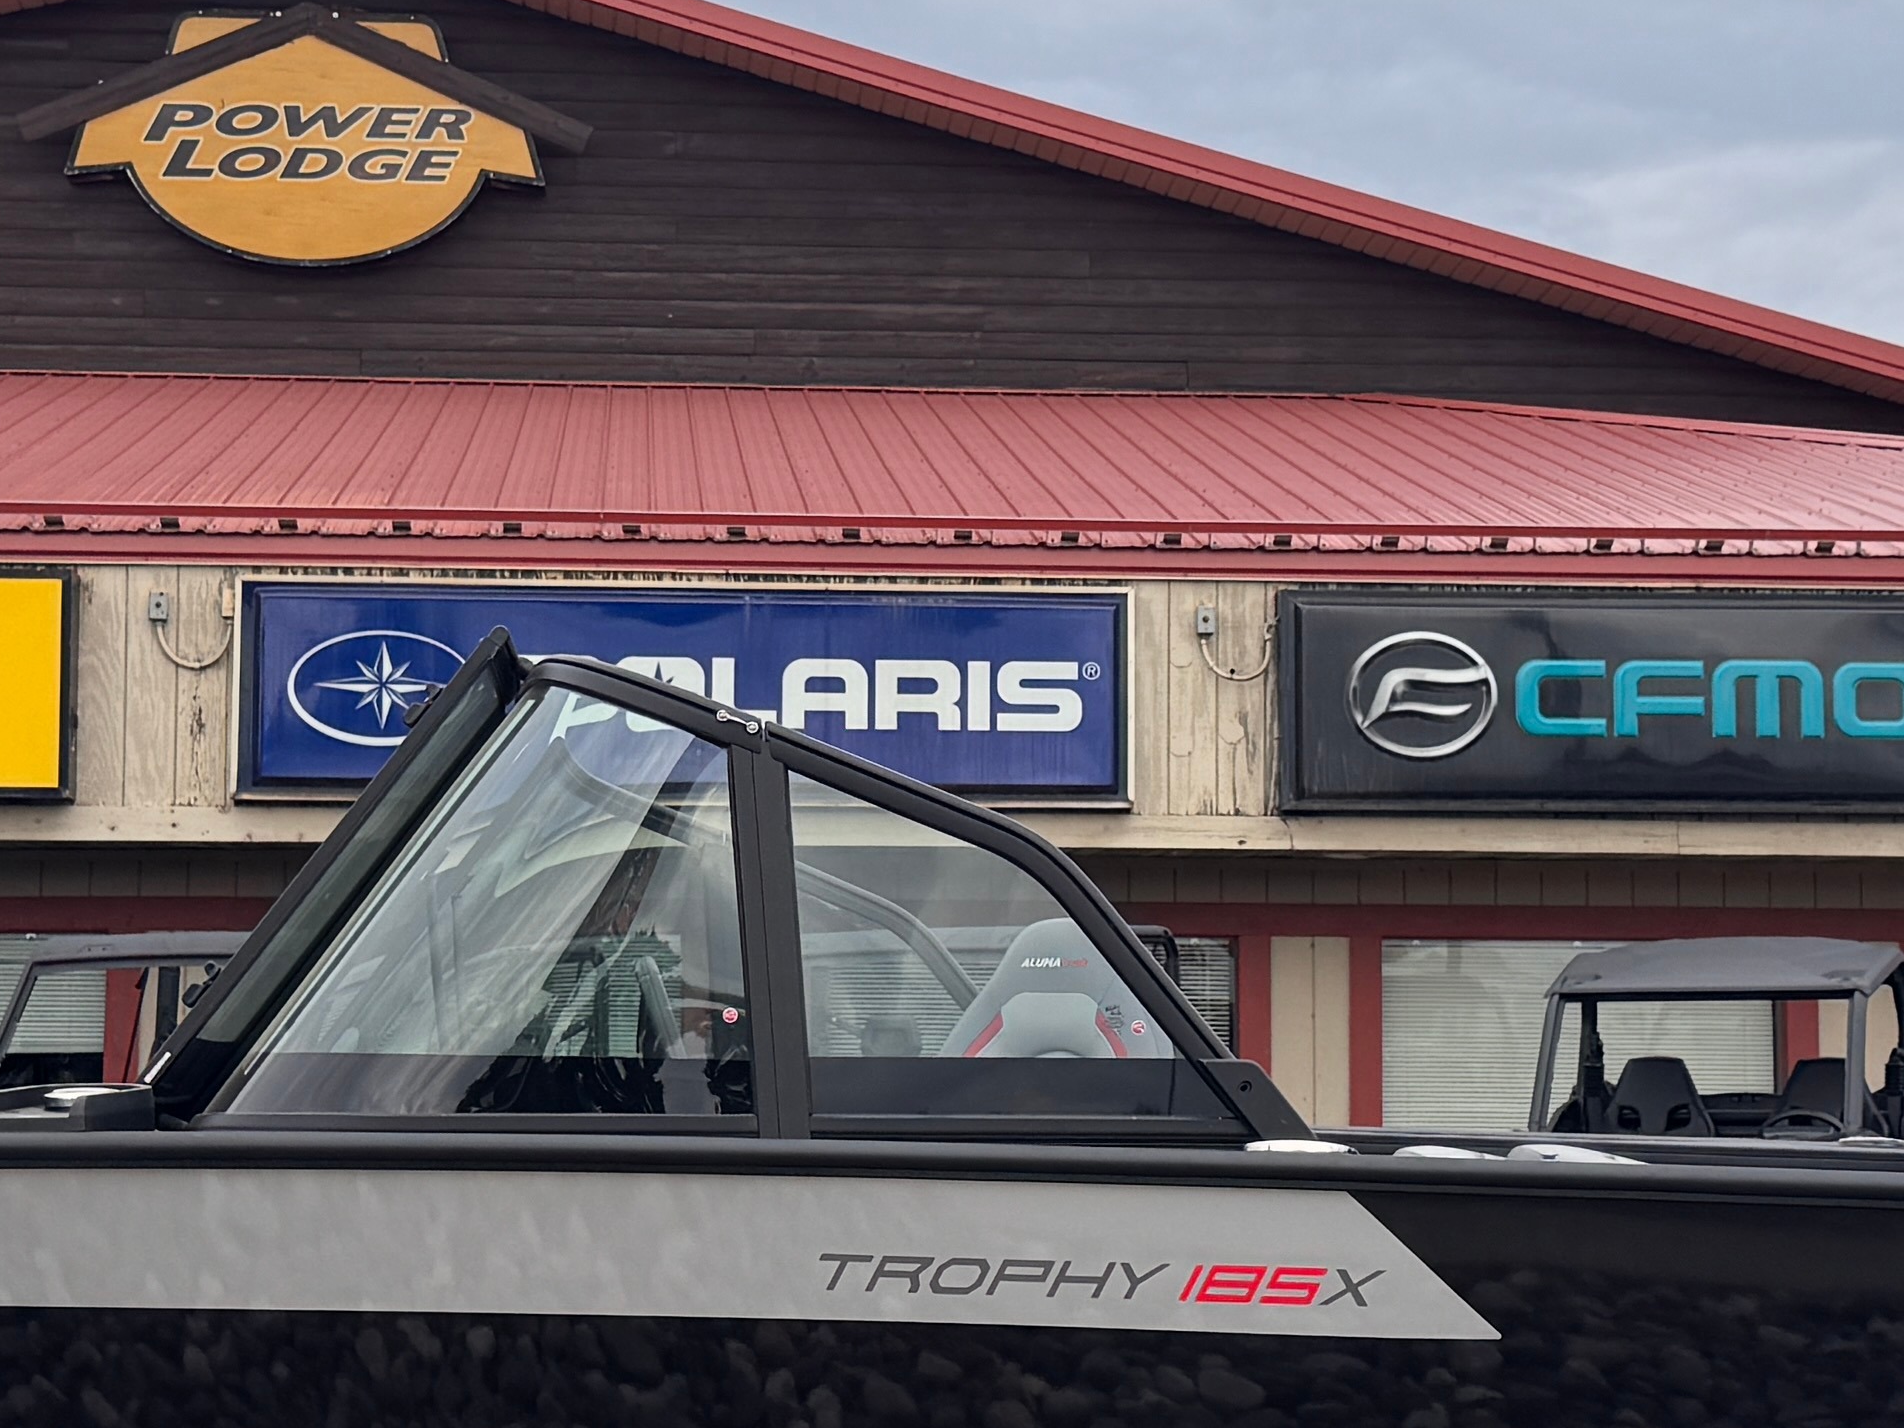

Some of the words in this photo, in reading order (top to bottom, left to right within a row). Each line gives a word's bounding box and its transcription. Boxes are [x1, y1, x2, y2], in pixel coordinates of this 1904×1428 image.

[143, 102, 472, 142] POWER
[161, 139, 460, 182] LODGE
[818, 1253, 1171, 1301] TROPHY
